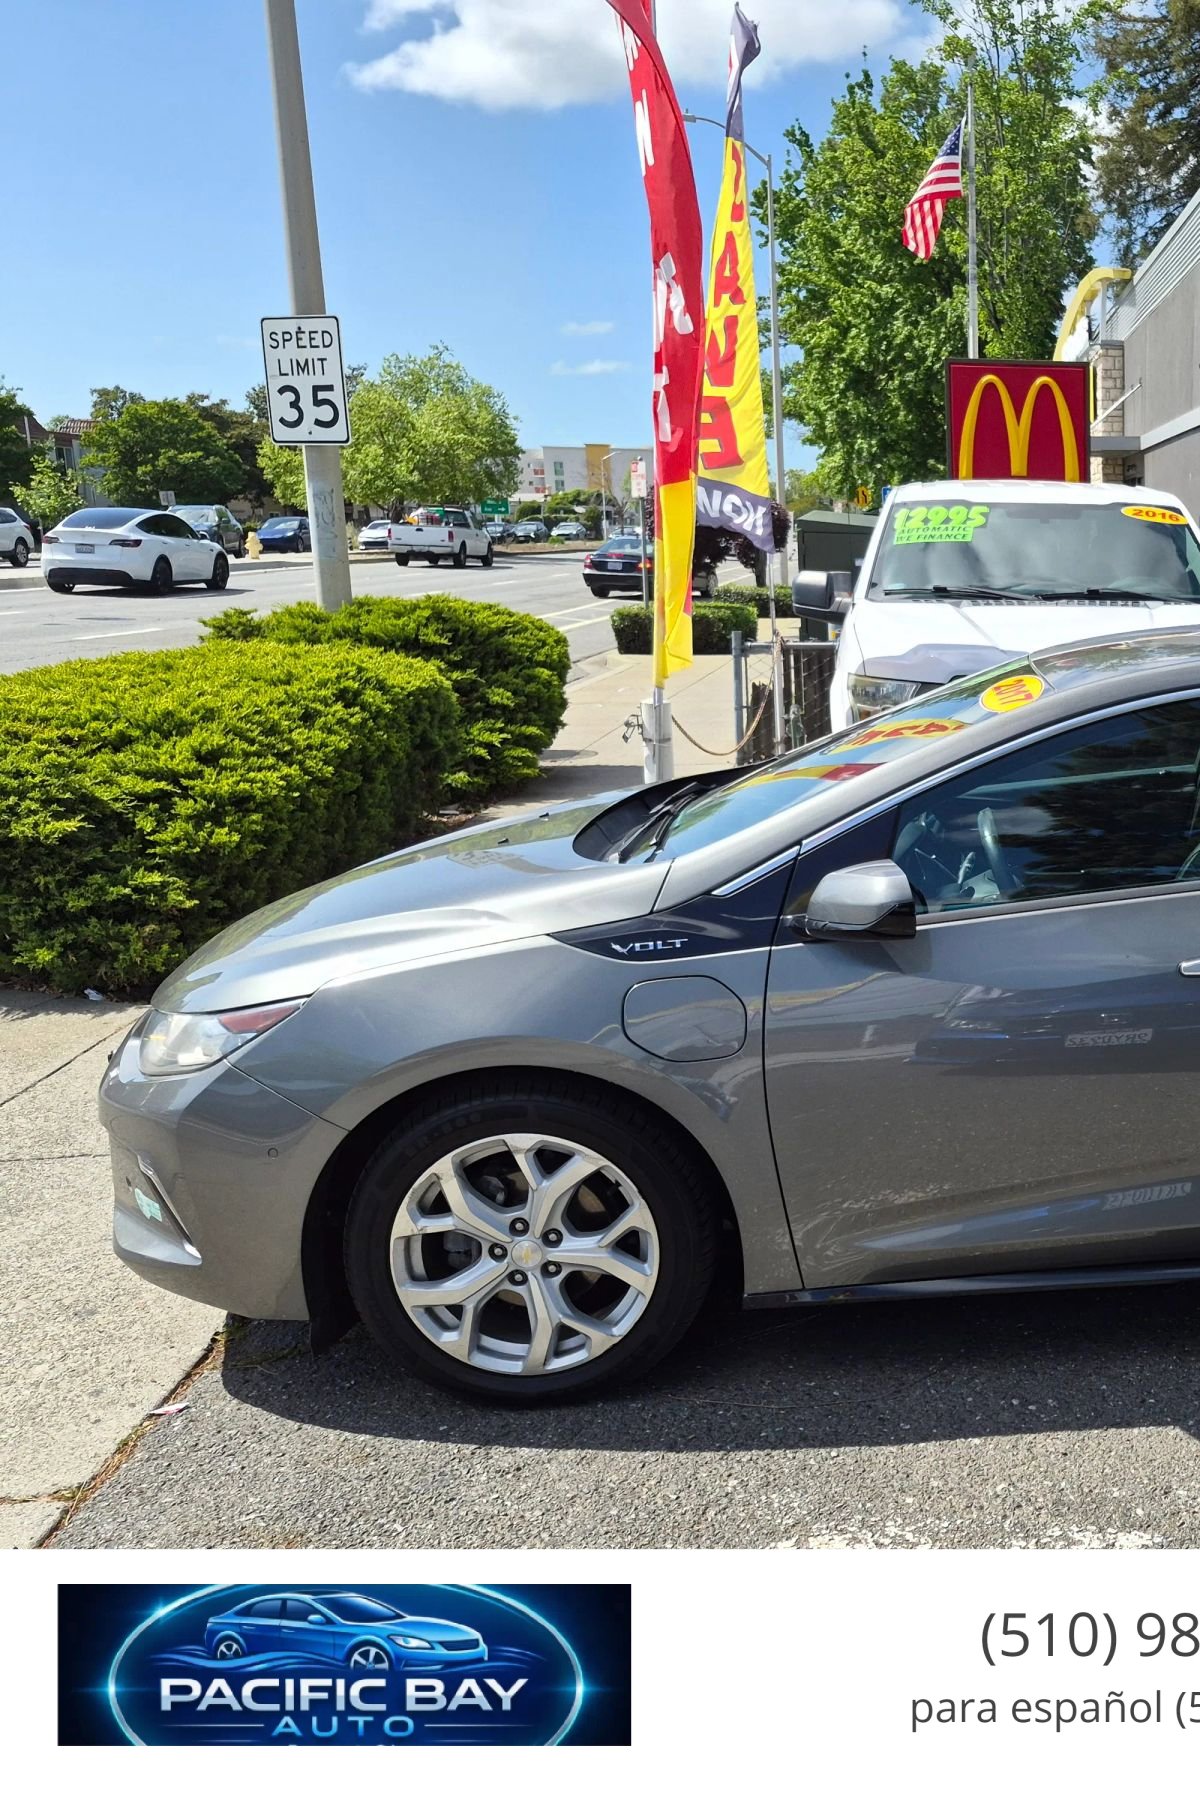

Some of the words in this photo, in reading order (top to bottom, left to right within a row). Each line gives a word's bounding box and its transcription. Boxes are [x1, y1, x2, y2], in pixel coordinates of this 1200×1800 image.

[269, 330, 333, 350] SPEED
[278, 358, 327, 376] LIMIT
[277, 384, 340, 429] 35
[895, 506, 989, 530] 12995
[1132, 509, 1180, 522] 2016
[899, 526, 969, 534] AUTOMATIC
[916, 533, 969, 541] FINANCE
[994, 679, 1034, 705] 2017
[611, 939, 688, 955] VOLT
